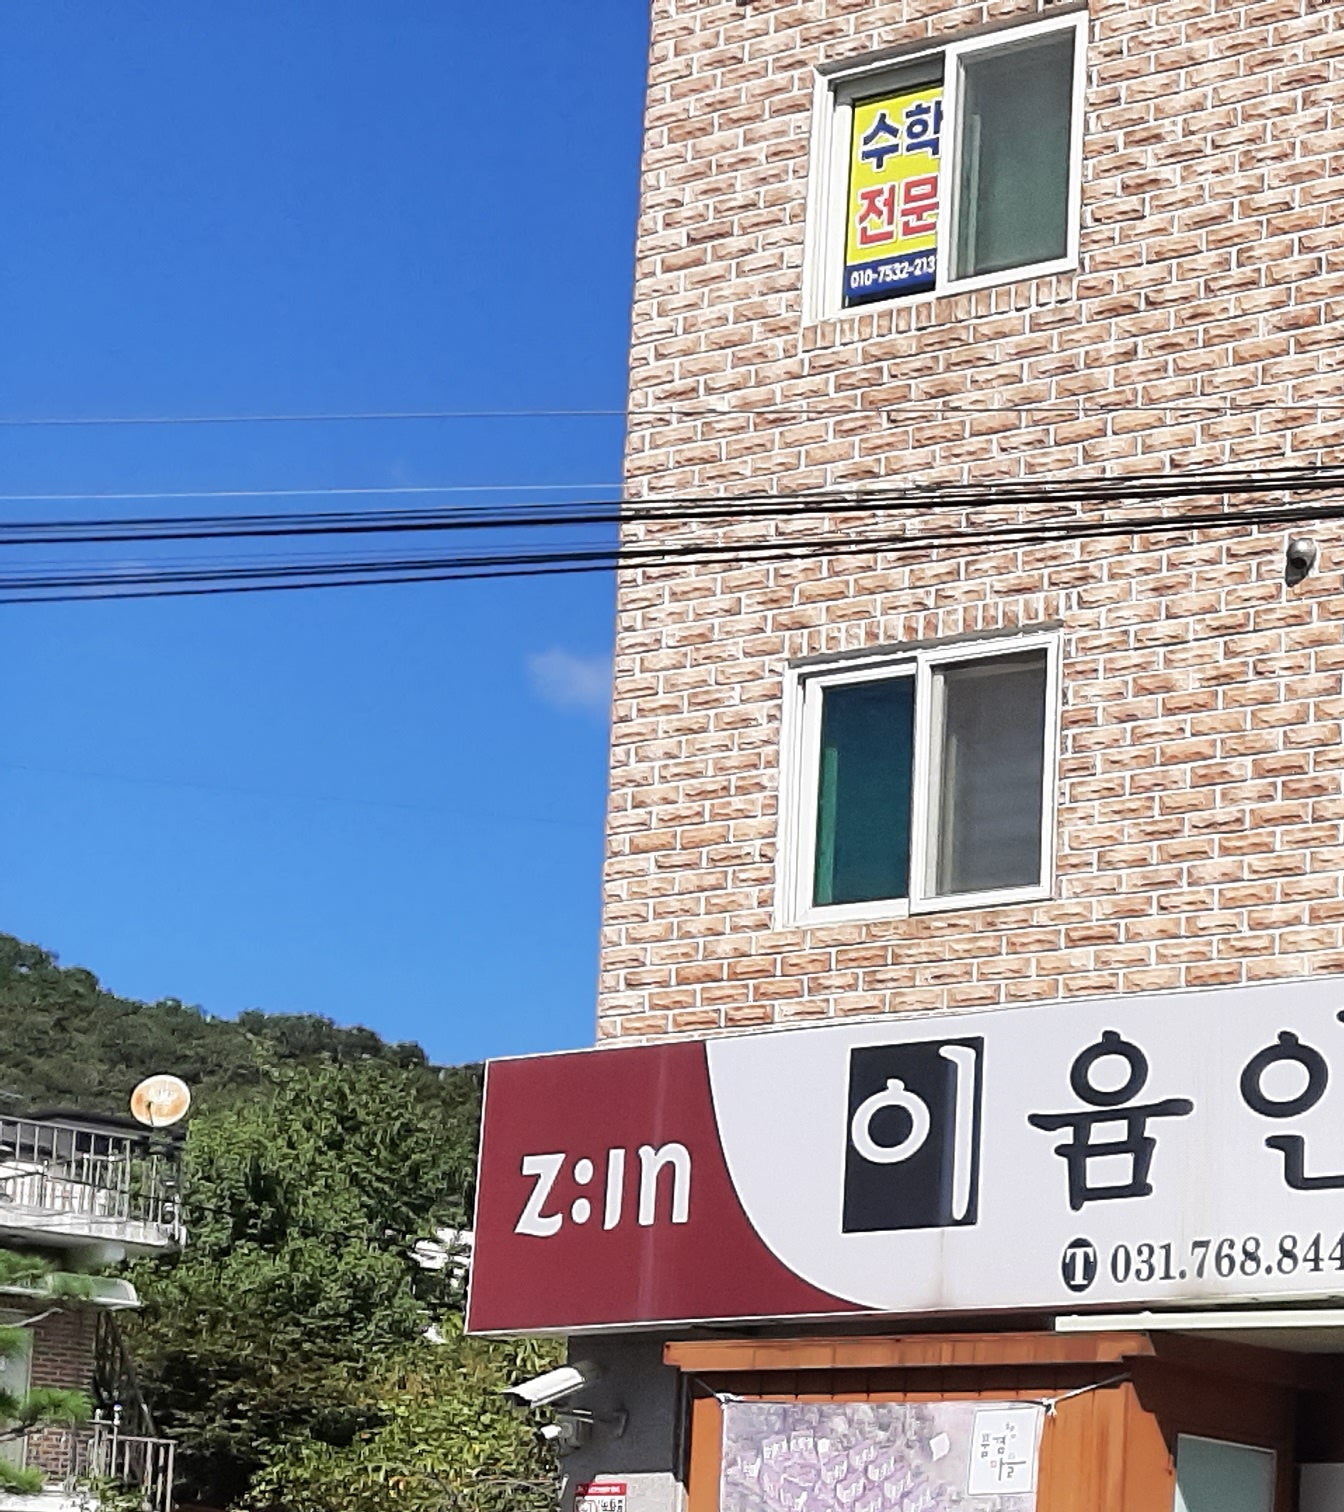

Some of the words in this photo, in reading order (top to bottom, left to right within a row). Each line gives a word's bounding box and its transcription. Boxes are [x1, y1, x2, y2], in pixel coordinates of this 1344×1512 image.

[861, 101, 943, 170] 수학
[858, 174, 938, 245] 전문
[850, 256, 937, 289] 010-7532-213
